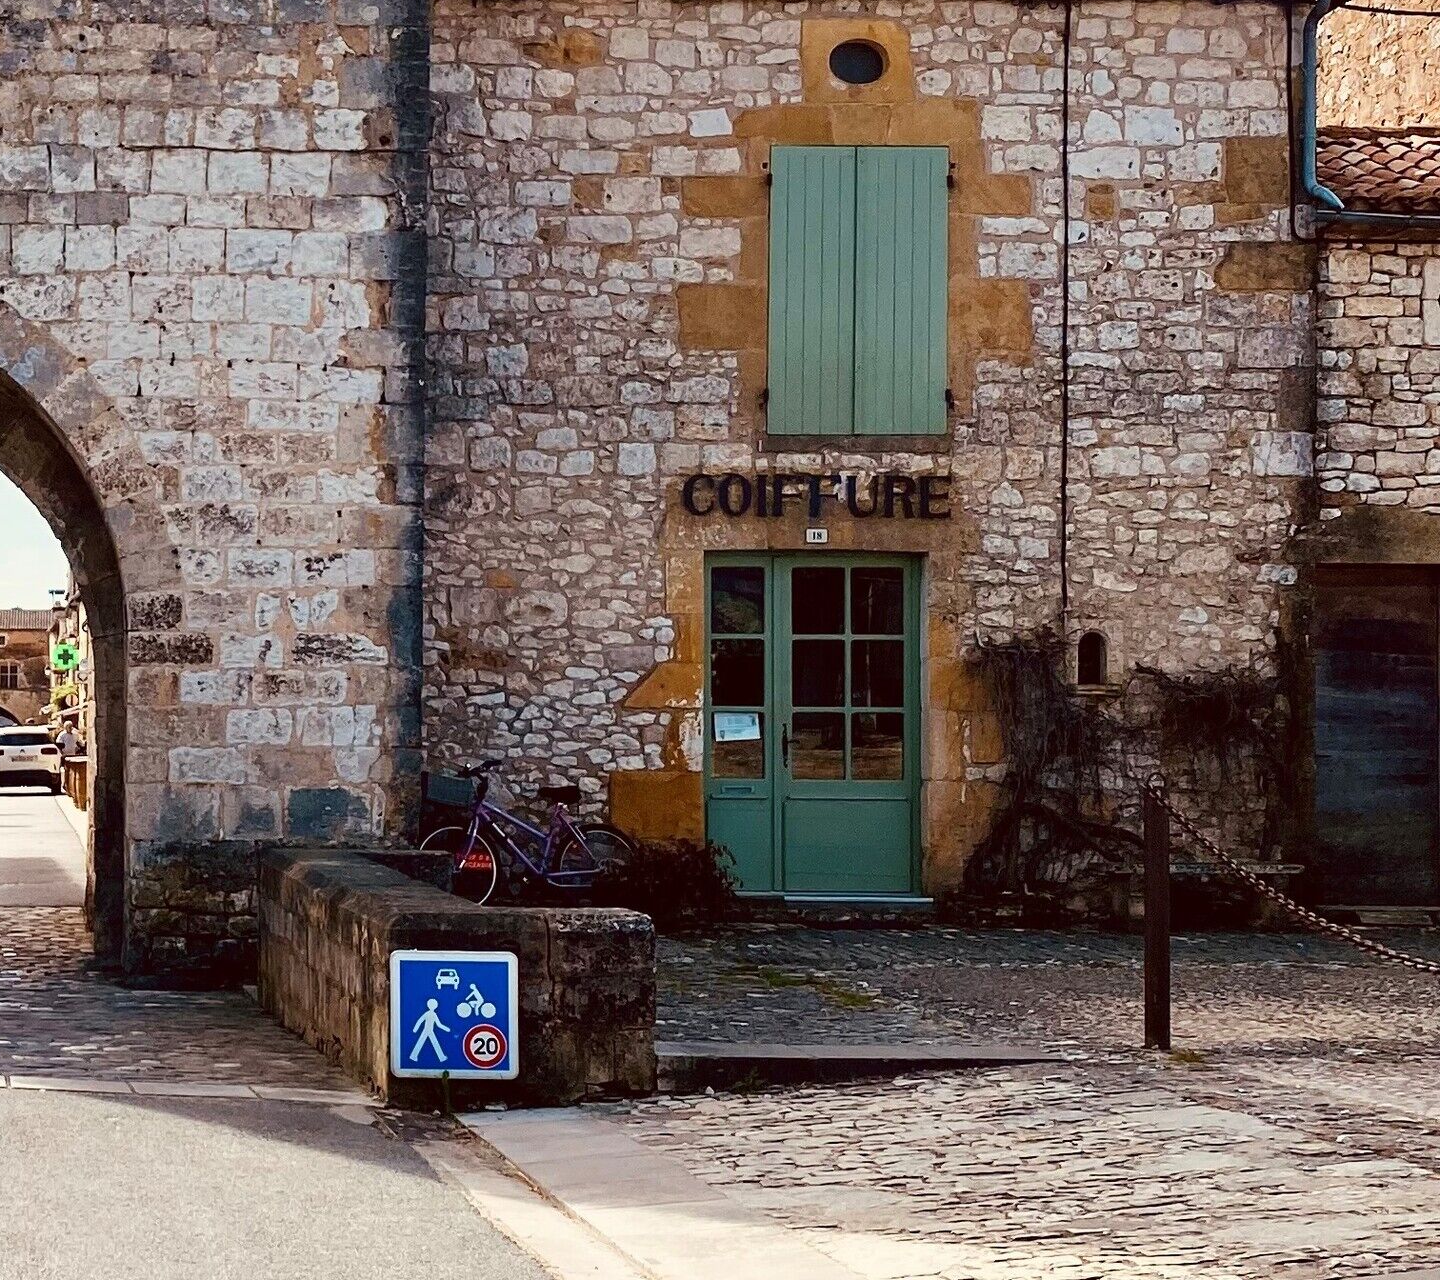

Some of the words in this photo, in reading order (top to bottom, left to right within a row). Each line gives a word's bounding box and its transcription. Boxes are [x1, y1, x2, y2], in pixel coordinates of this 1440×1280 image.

[682, 472, 952, 519] COIFFURE
[812, 530, 823, 540] 18
[473, 1037, 499, 1055] 20
